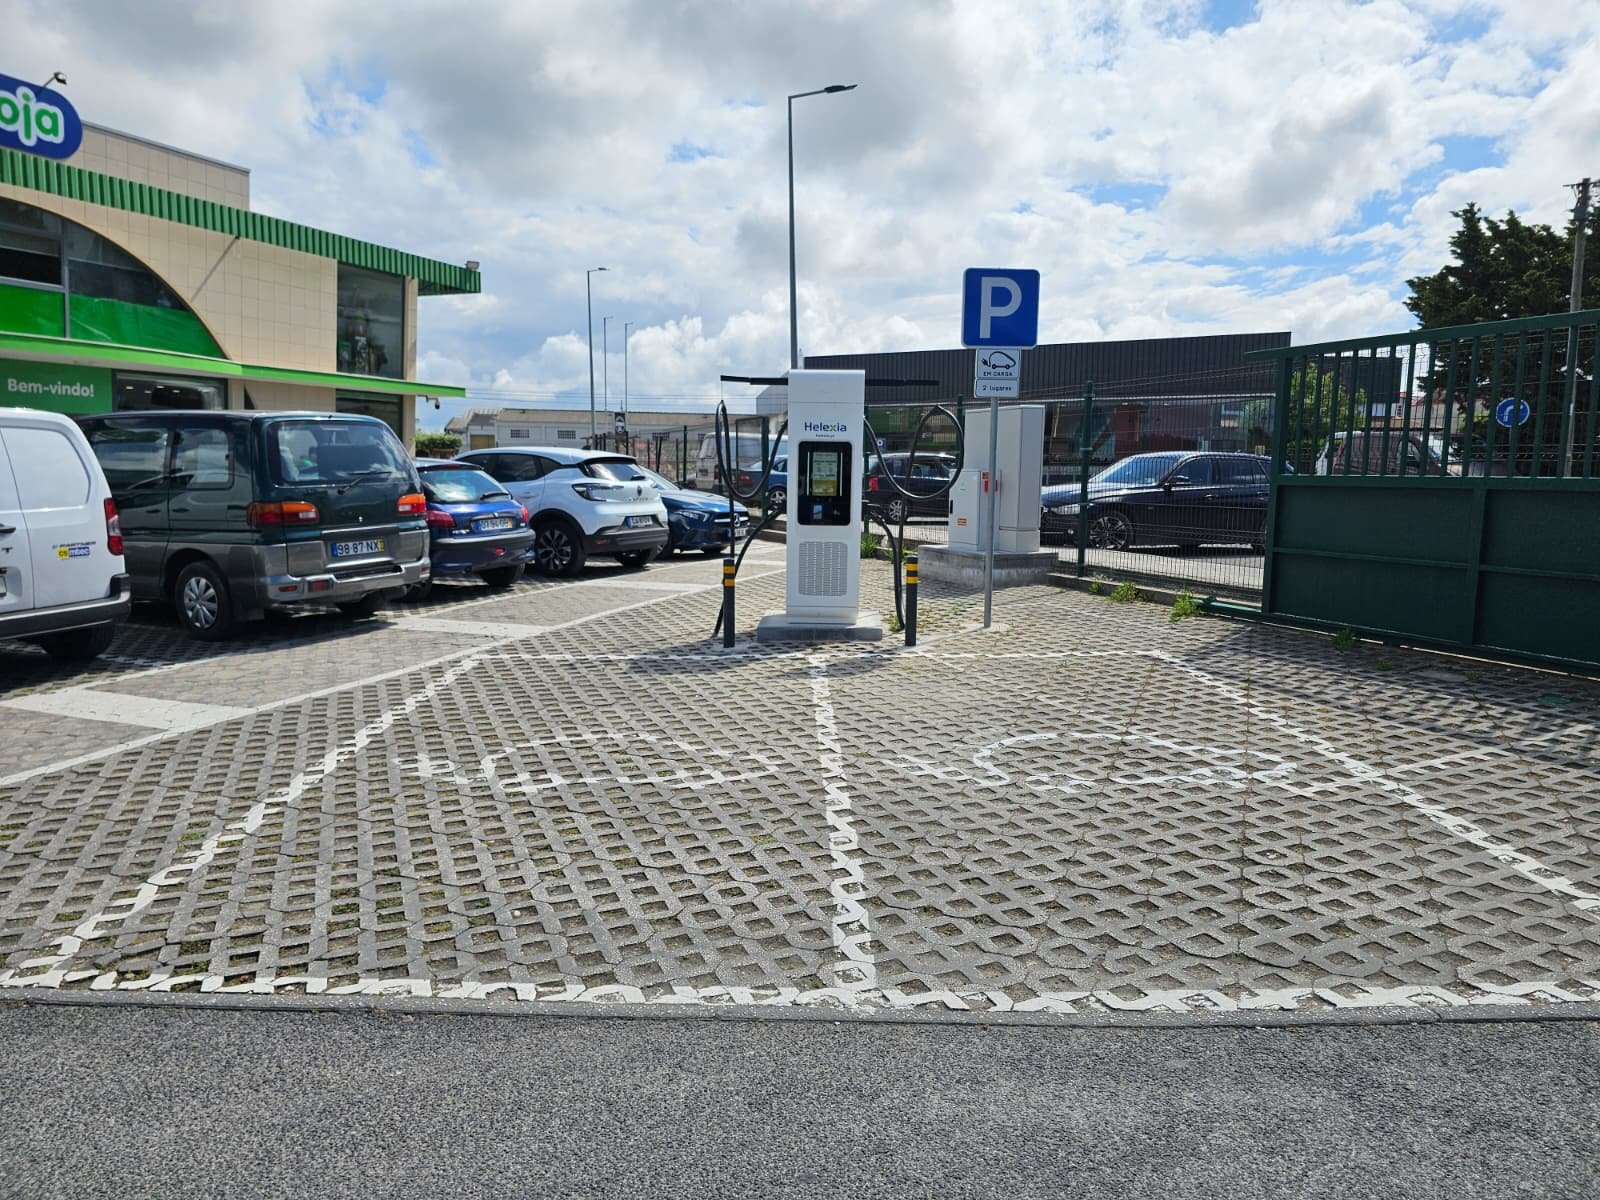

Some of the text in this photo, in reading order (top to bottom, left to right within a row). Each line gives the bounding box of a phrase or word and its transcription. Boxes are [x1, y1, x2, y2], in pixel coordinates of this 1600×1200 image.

[979, 276, 1022, 339] P
[7, 378, 95, 398] Bem-vindo!
[804, 421, 848, 432] Helexia
